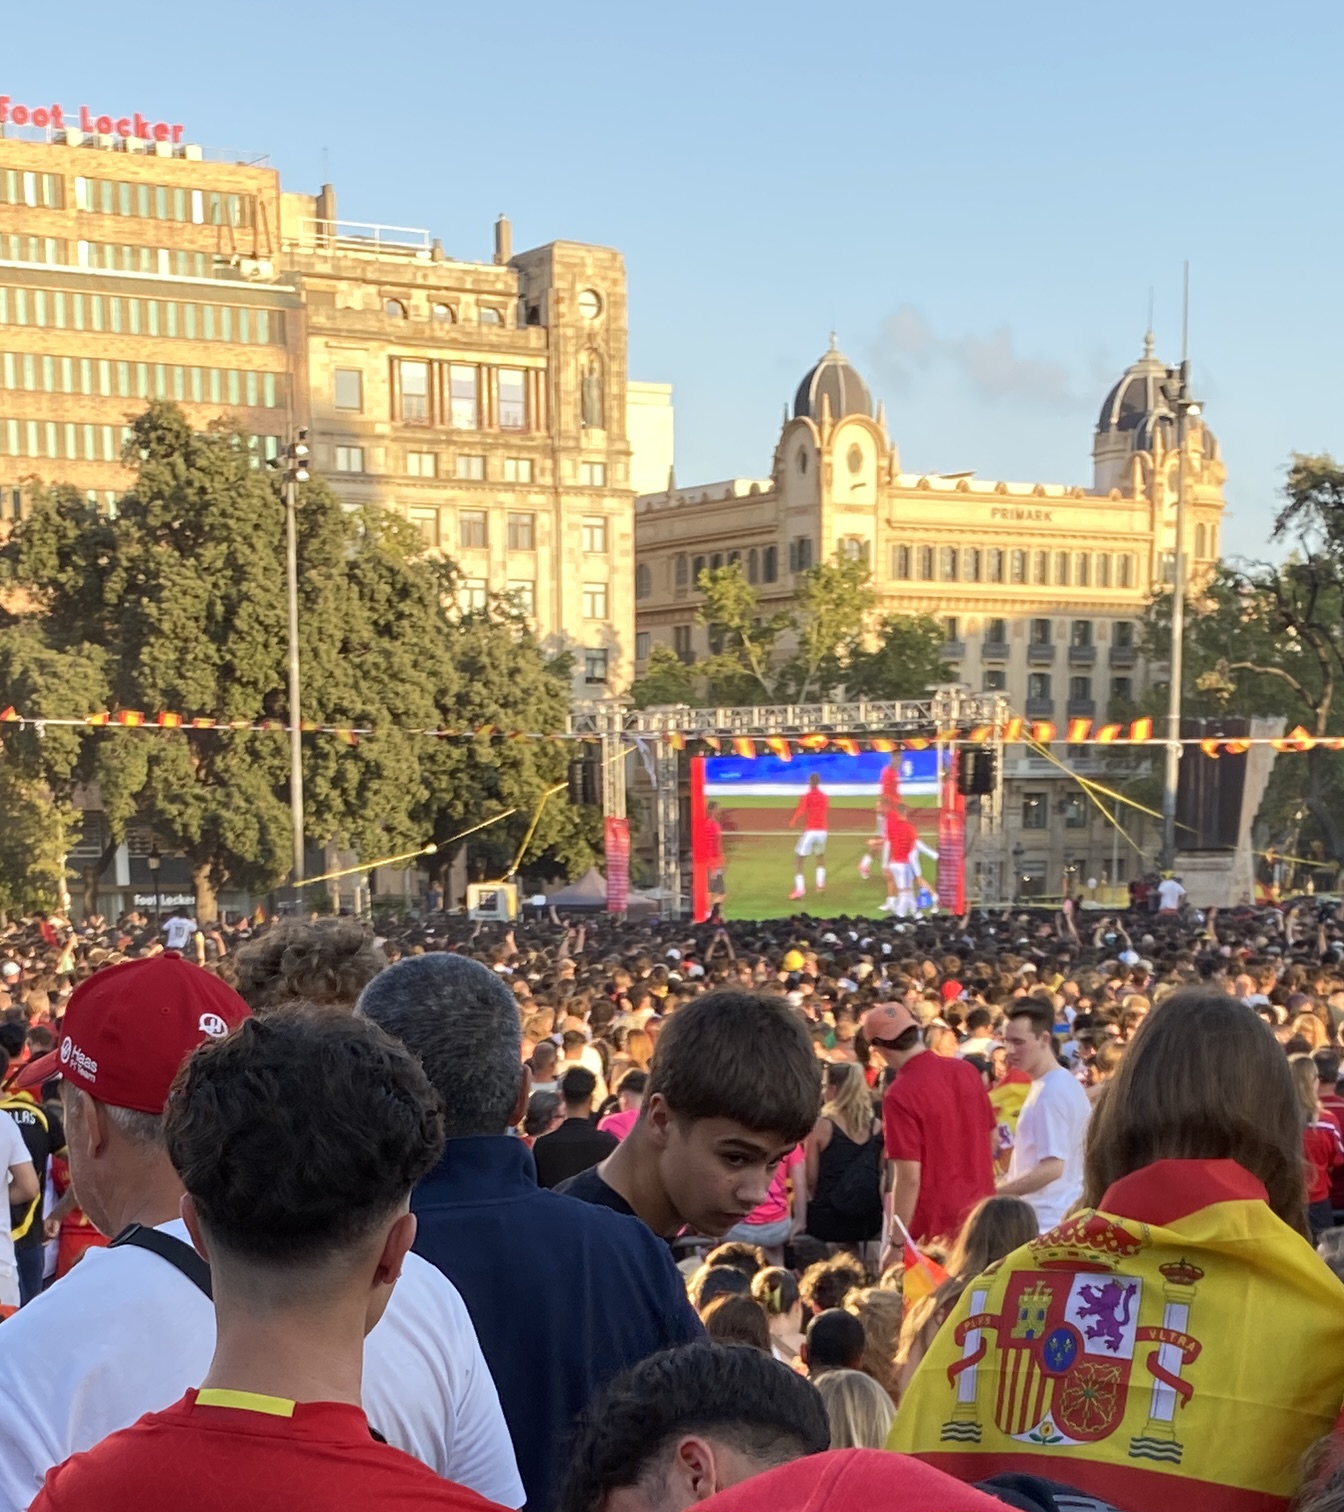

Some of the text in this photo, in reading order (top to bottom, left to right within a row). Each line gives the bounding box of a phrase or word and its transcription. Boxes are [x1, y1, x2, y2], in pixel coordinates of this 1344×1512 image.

[79, 105, 184, 143] Locker
[990, 507, 1053, 522] PRIMARK
[71, 1045, 97, 1073] Haas
